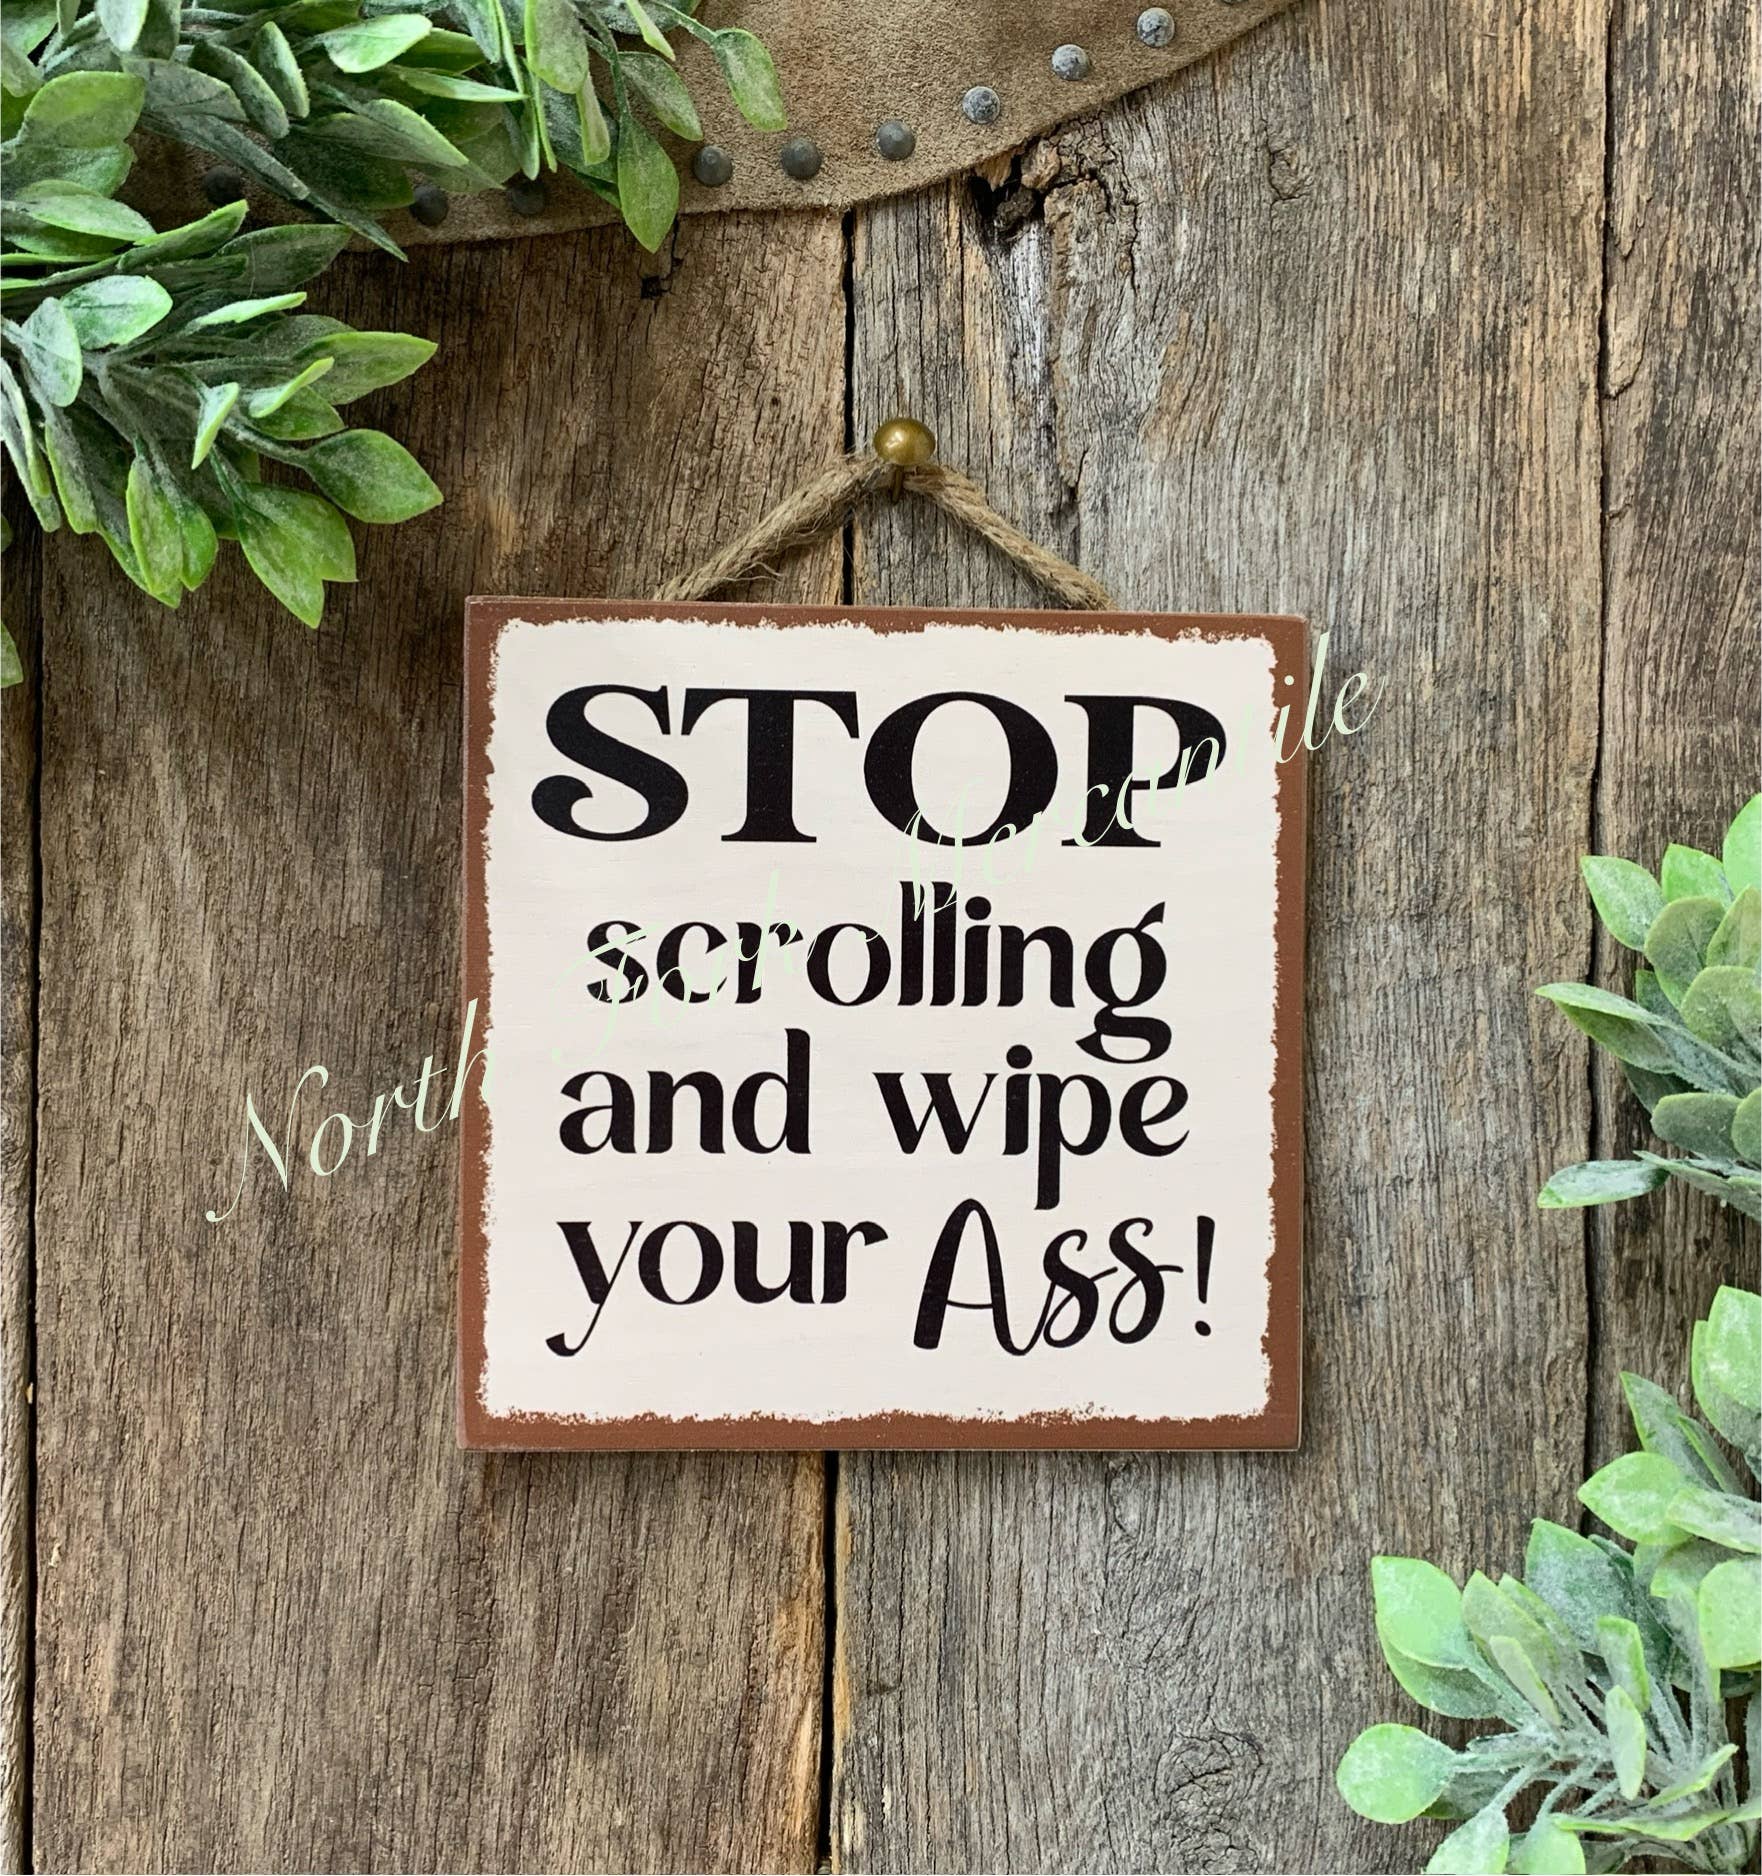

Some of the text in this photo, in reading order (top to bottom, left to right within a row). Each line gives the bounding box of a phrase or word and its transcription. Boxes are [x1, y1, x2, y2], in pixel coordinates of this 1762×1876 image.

[531, 684, 1228, 849] STOP
[586, 880, 1172, 1065] scrolling
[559, 1028, 1190, 1211] and wipe
[545, 1198, 1217, 1357] your Ass!
